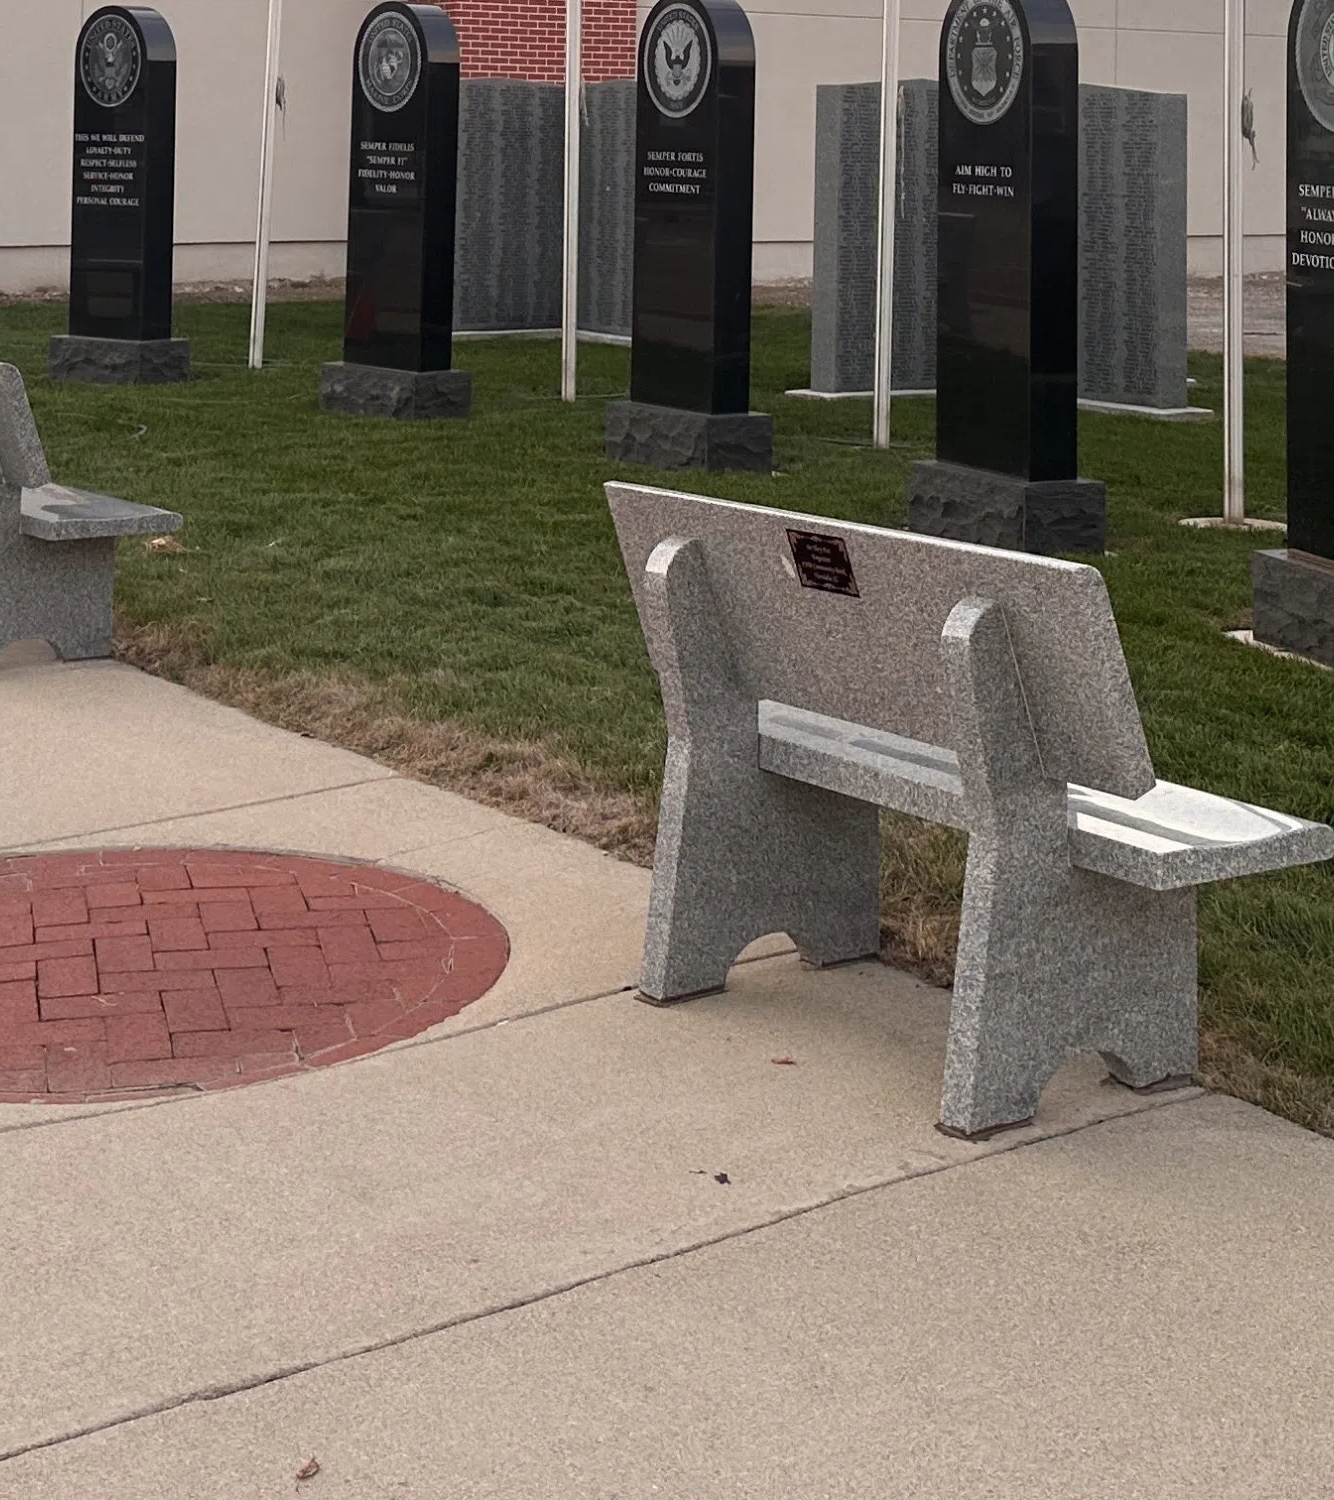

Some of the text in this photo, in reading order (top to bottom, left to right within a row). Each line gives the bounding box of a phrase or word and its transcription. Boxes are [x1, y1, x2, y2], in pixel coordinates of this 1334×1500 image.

[360, 141, 387, 150] SEMPER
[647, 151, 704, 162] SEMPER FORTIS
[955, 164, 1013, 178] AIM HIGH TO
[375, 184, 397, 193] VALOR
[648, 182, 701, 194] COMMITMENT
